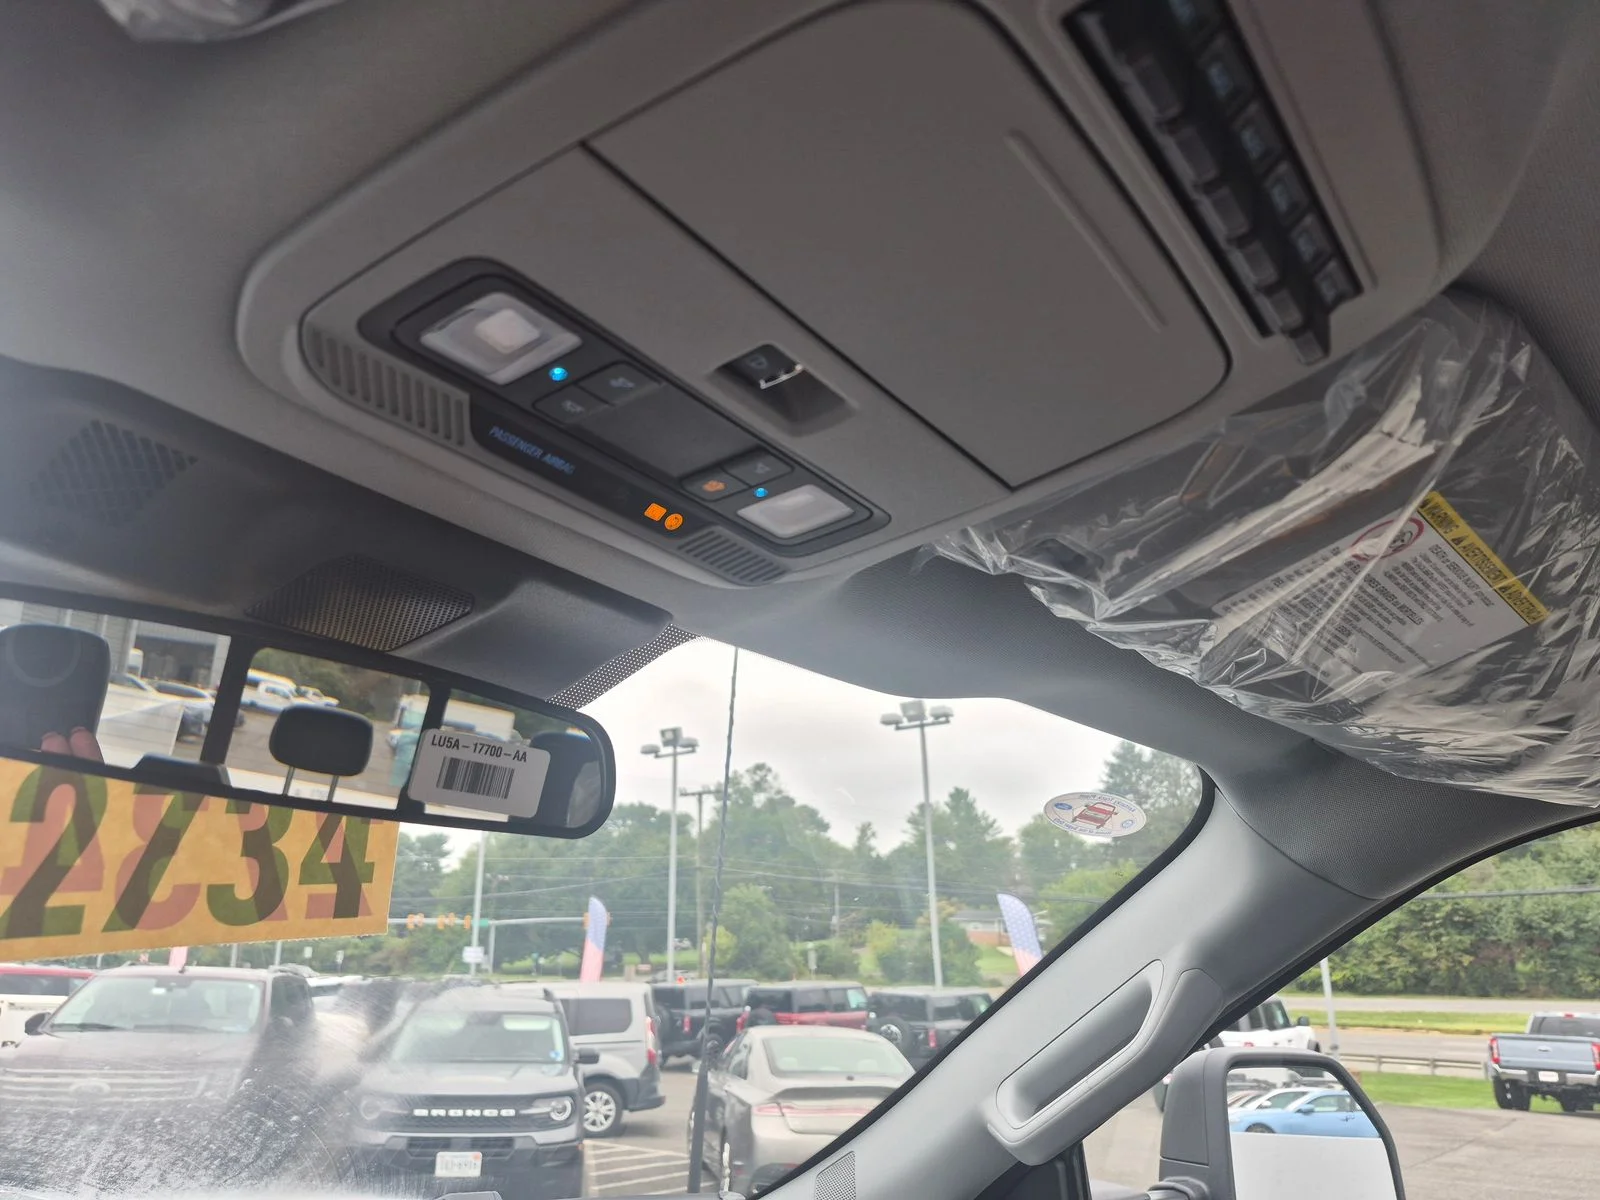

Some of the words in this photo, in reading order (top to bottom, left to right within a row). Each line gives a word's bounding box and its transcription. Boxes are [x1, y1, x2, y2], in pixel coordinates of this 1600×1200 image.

[489, 426, 543, 458] PASSENGER
[542, 453, 575, 475] AIRBAG
[412, 1108, 516, 1117] BRONCO
